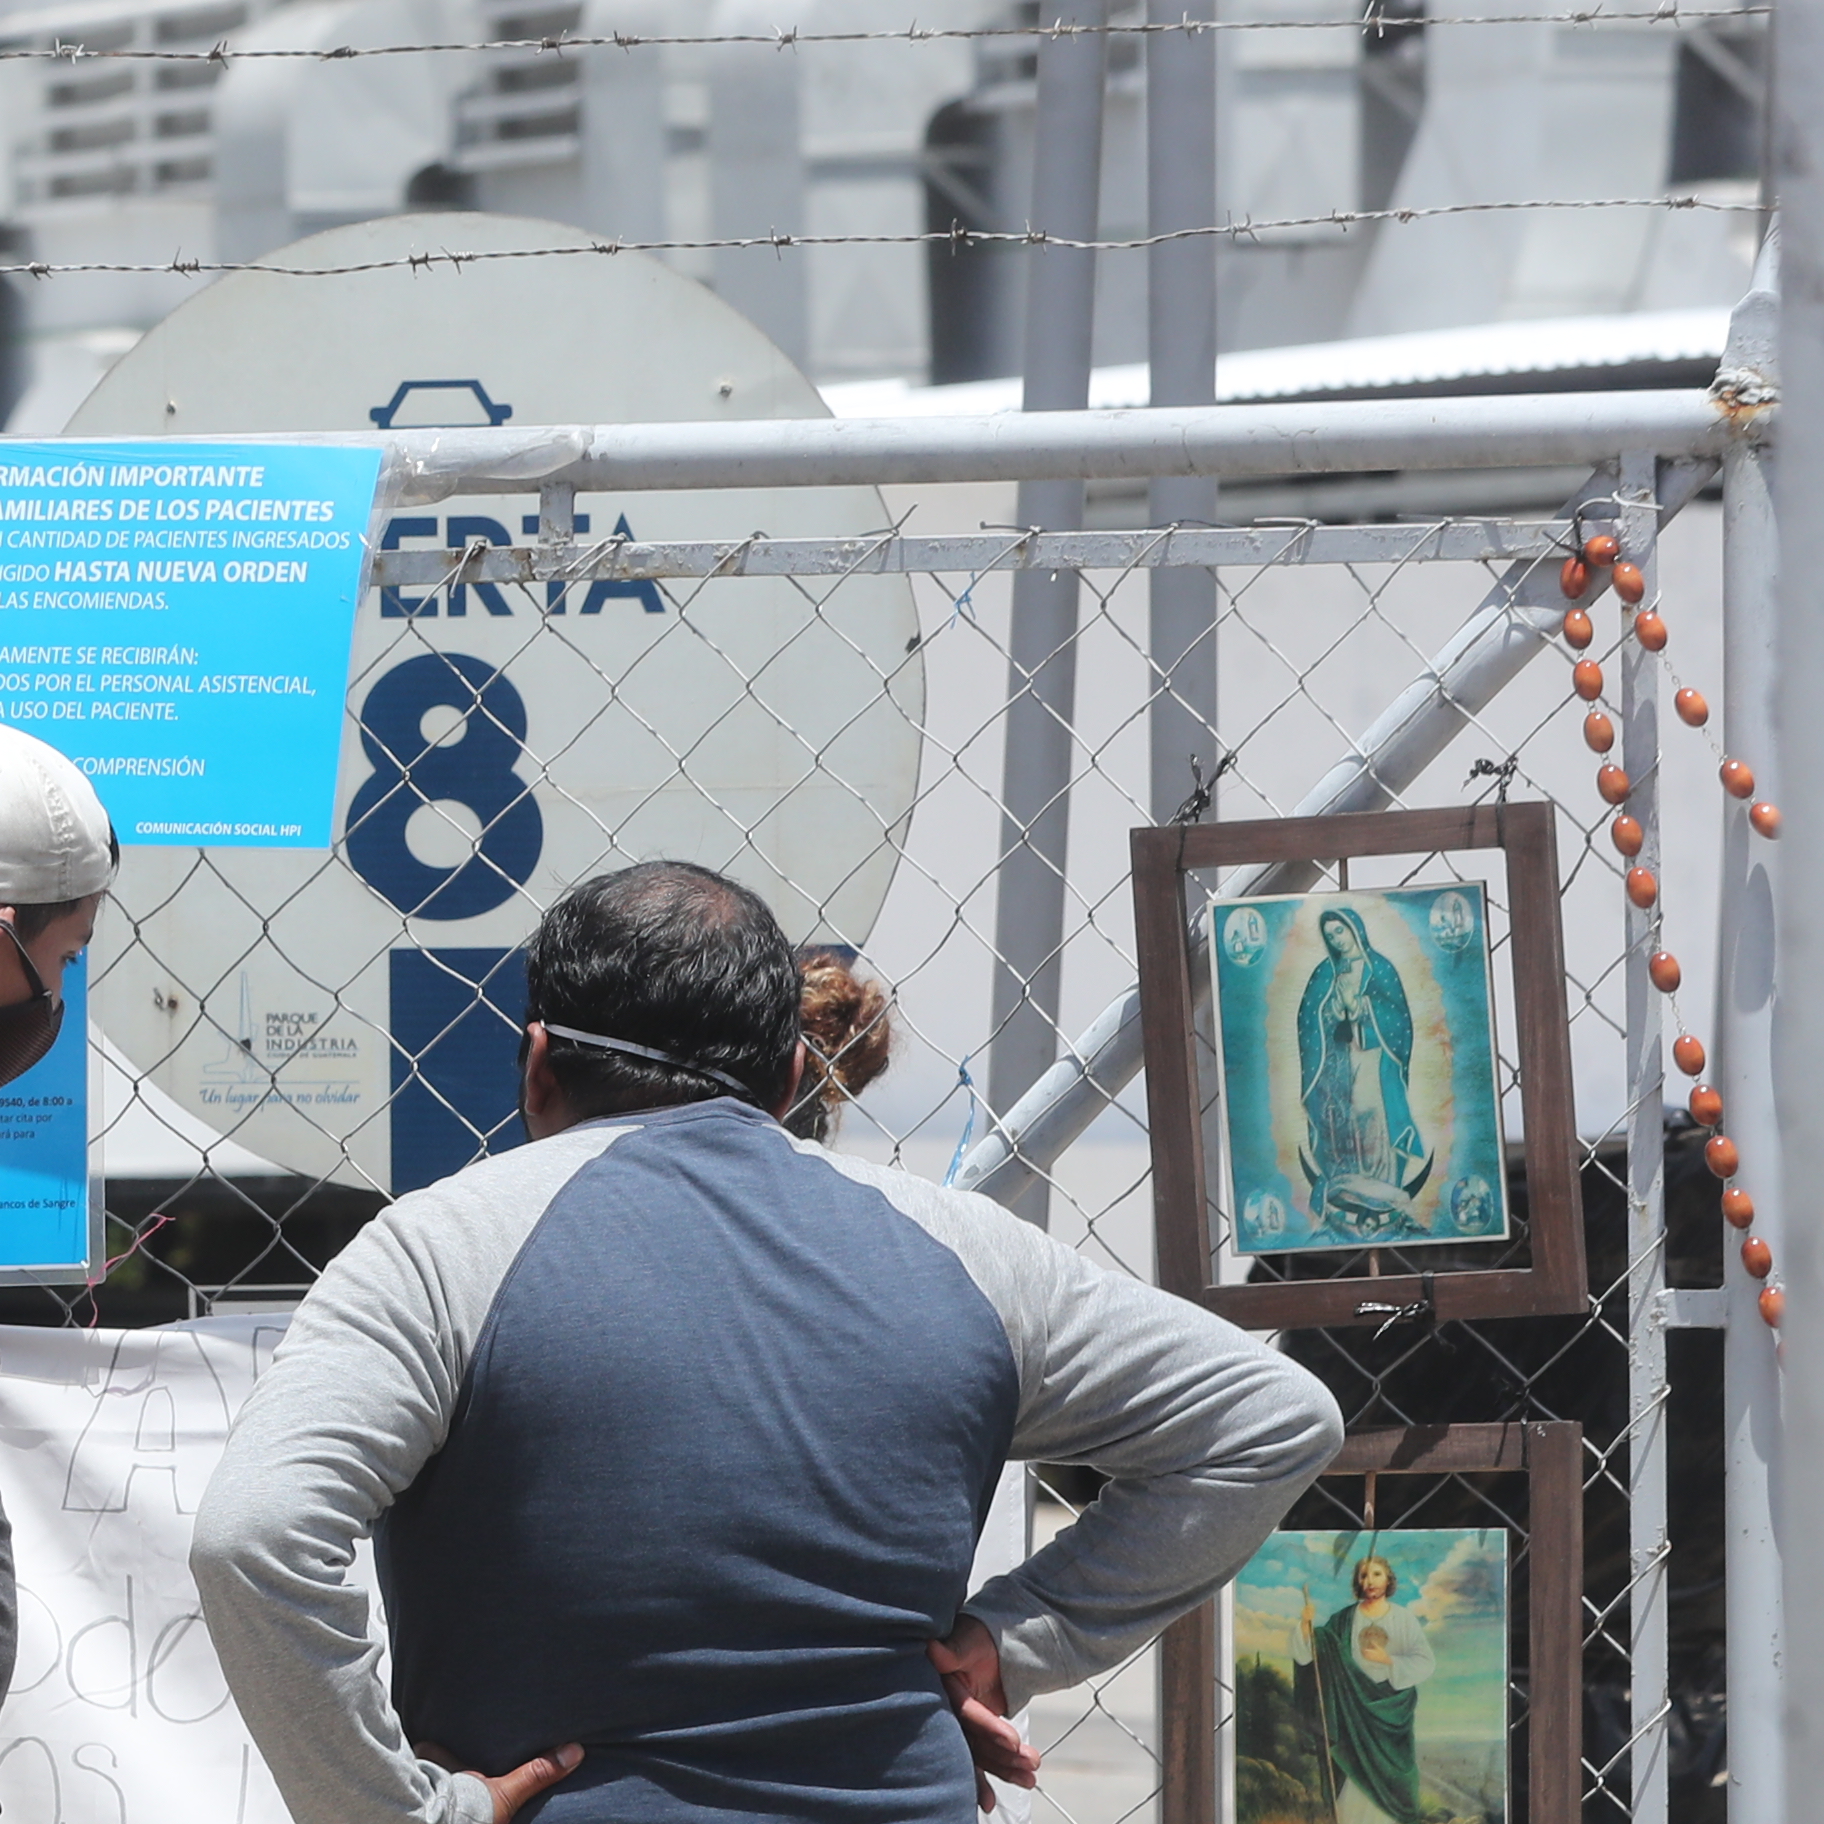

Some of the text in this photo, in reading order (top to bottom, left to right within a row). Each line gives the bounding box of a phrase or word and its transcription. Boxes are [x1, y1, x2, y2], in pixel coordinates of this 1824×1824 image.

[109, 465, 265, 488] IMPORTANTE
[118, 499, 151, 521] DE
[155, 499, 200, 521] LOS
[205, 500, 334, 523] PACIENTES
[6, 530, 102, 549] CANTIDAD
[105, 530, 130, 549] DE
[133, 530, 228, 549] PACIENTES
[232, 530, 351, 550] INGRESADOS
[54, 560, 131, 583] HASTA
[136, 561, 218, 583] NUEVA
[222, 561, 308, 583] ORDEN
[33, 591, 169, 610] ENCOMIENDAS.
[75, 646, 97, 665] SE
[100, 644, 199, 666] RECIBIRÁN:
[34, 674, 72, 692] POR
[75, 674, 95, 692] EL
[100, 674, 194, 693] PERSONAL
[197, 675, 317, 697] ASISTENCIAL,
[10, 701, 49, 719] USO
[52, 702, 86, 719] DEL
[90, 702, 179, 721] PACIENTE.
[73, 755, 205, 777] COMPRENSIÓN
[345, 652, 544, 921] 8
[135, 820, 302, 837] COMUNICACIÓN SOCIAL HPI
[265, 1012, 319, 1026] PARQUE
[266, 1023, 303, 1037] DE LA
[265, 1037, 358, 1051] INDUSTRIA
[28, 1096, 40, 1107] de
[225, 1085, 260, 1114] lugar
[16, 1112, 33, 1124] cita
[28, 1198, 40, 1209] de
[43, 1198, 76, 1211] Sangre
